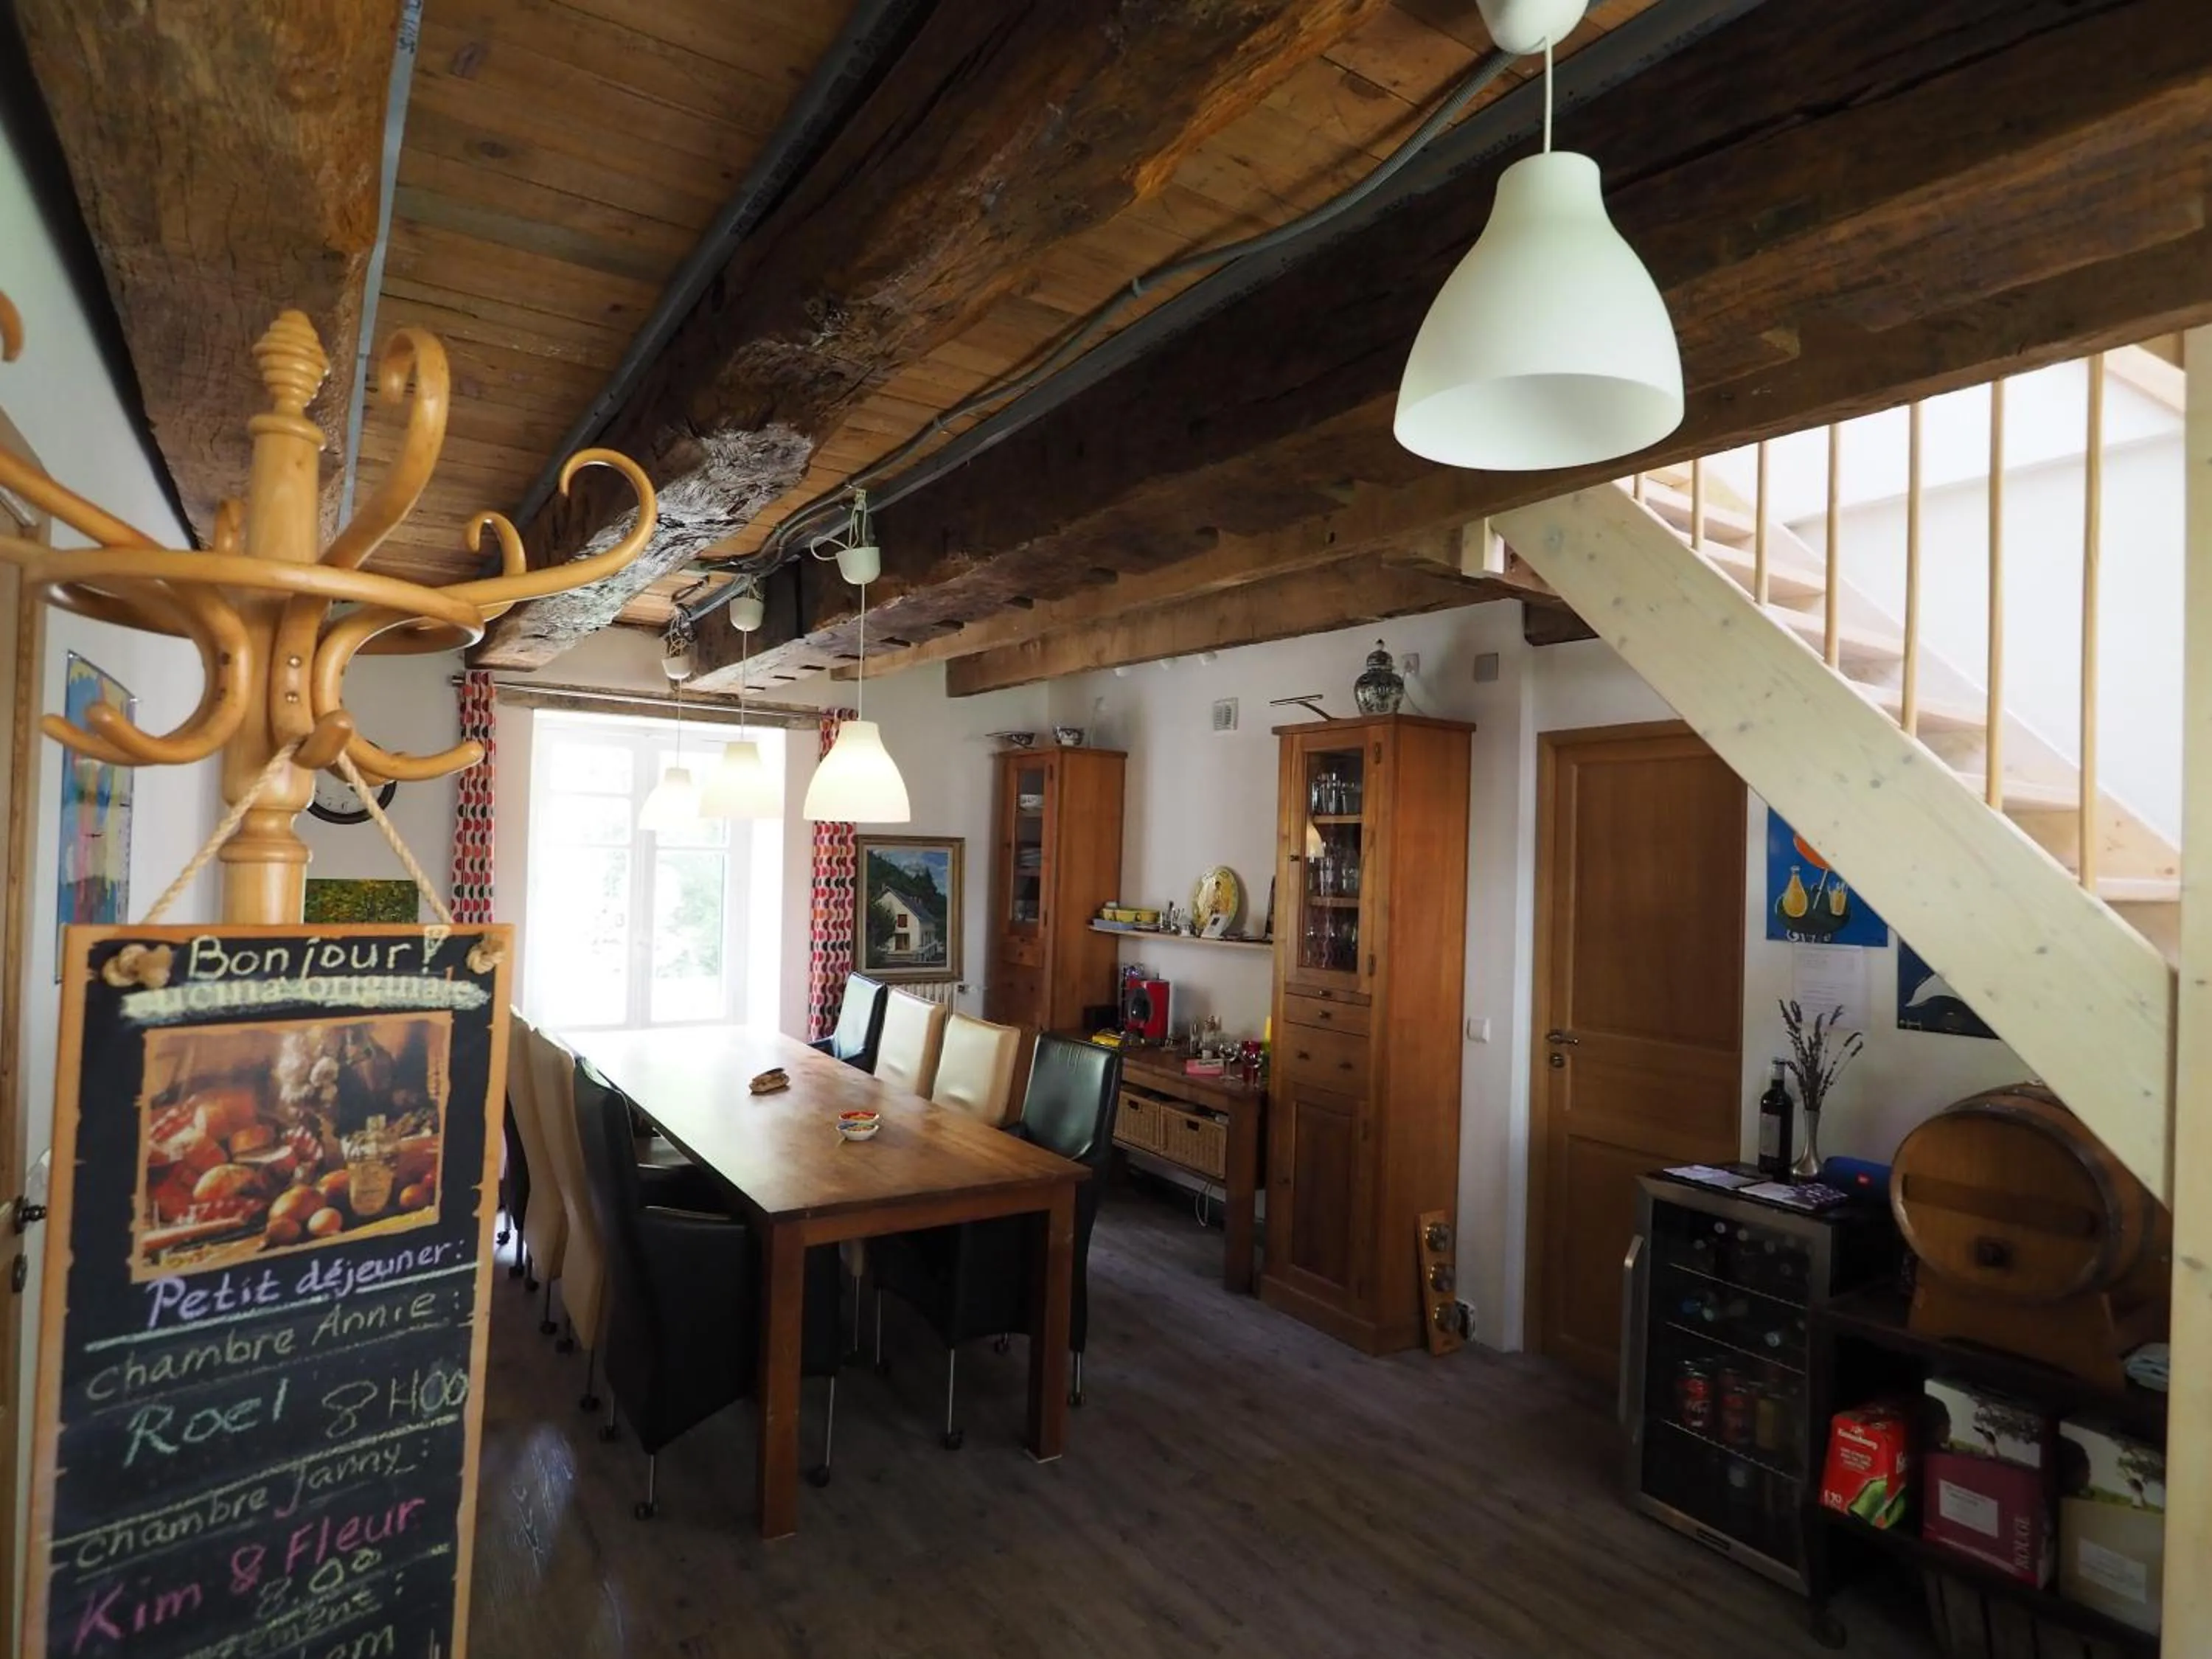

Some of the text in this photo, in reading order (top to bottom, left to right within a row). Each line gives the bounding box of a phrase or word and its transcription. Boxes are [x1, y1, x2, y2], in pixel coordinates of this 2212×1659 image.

[146, 1270, 280, 1328] Petit
[74, 1578, 203, 1653] Kim
[285, 1499, 425, 1573] Fleur
